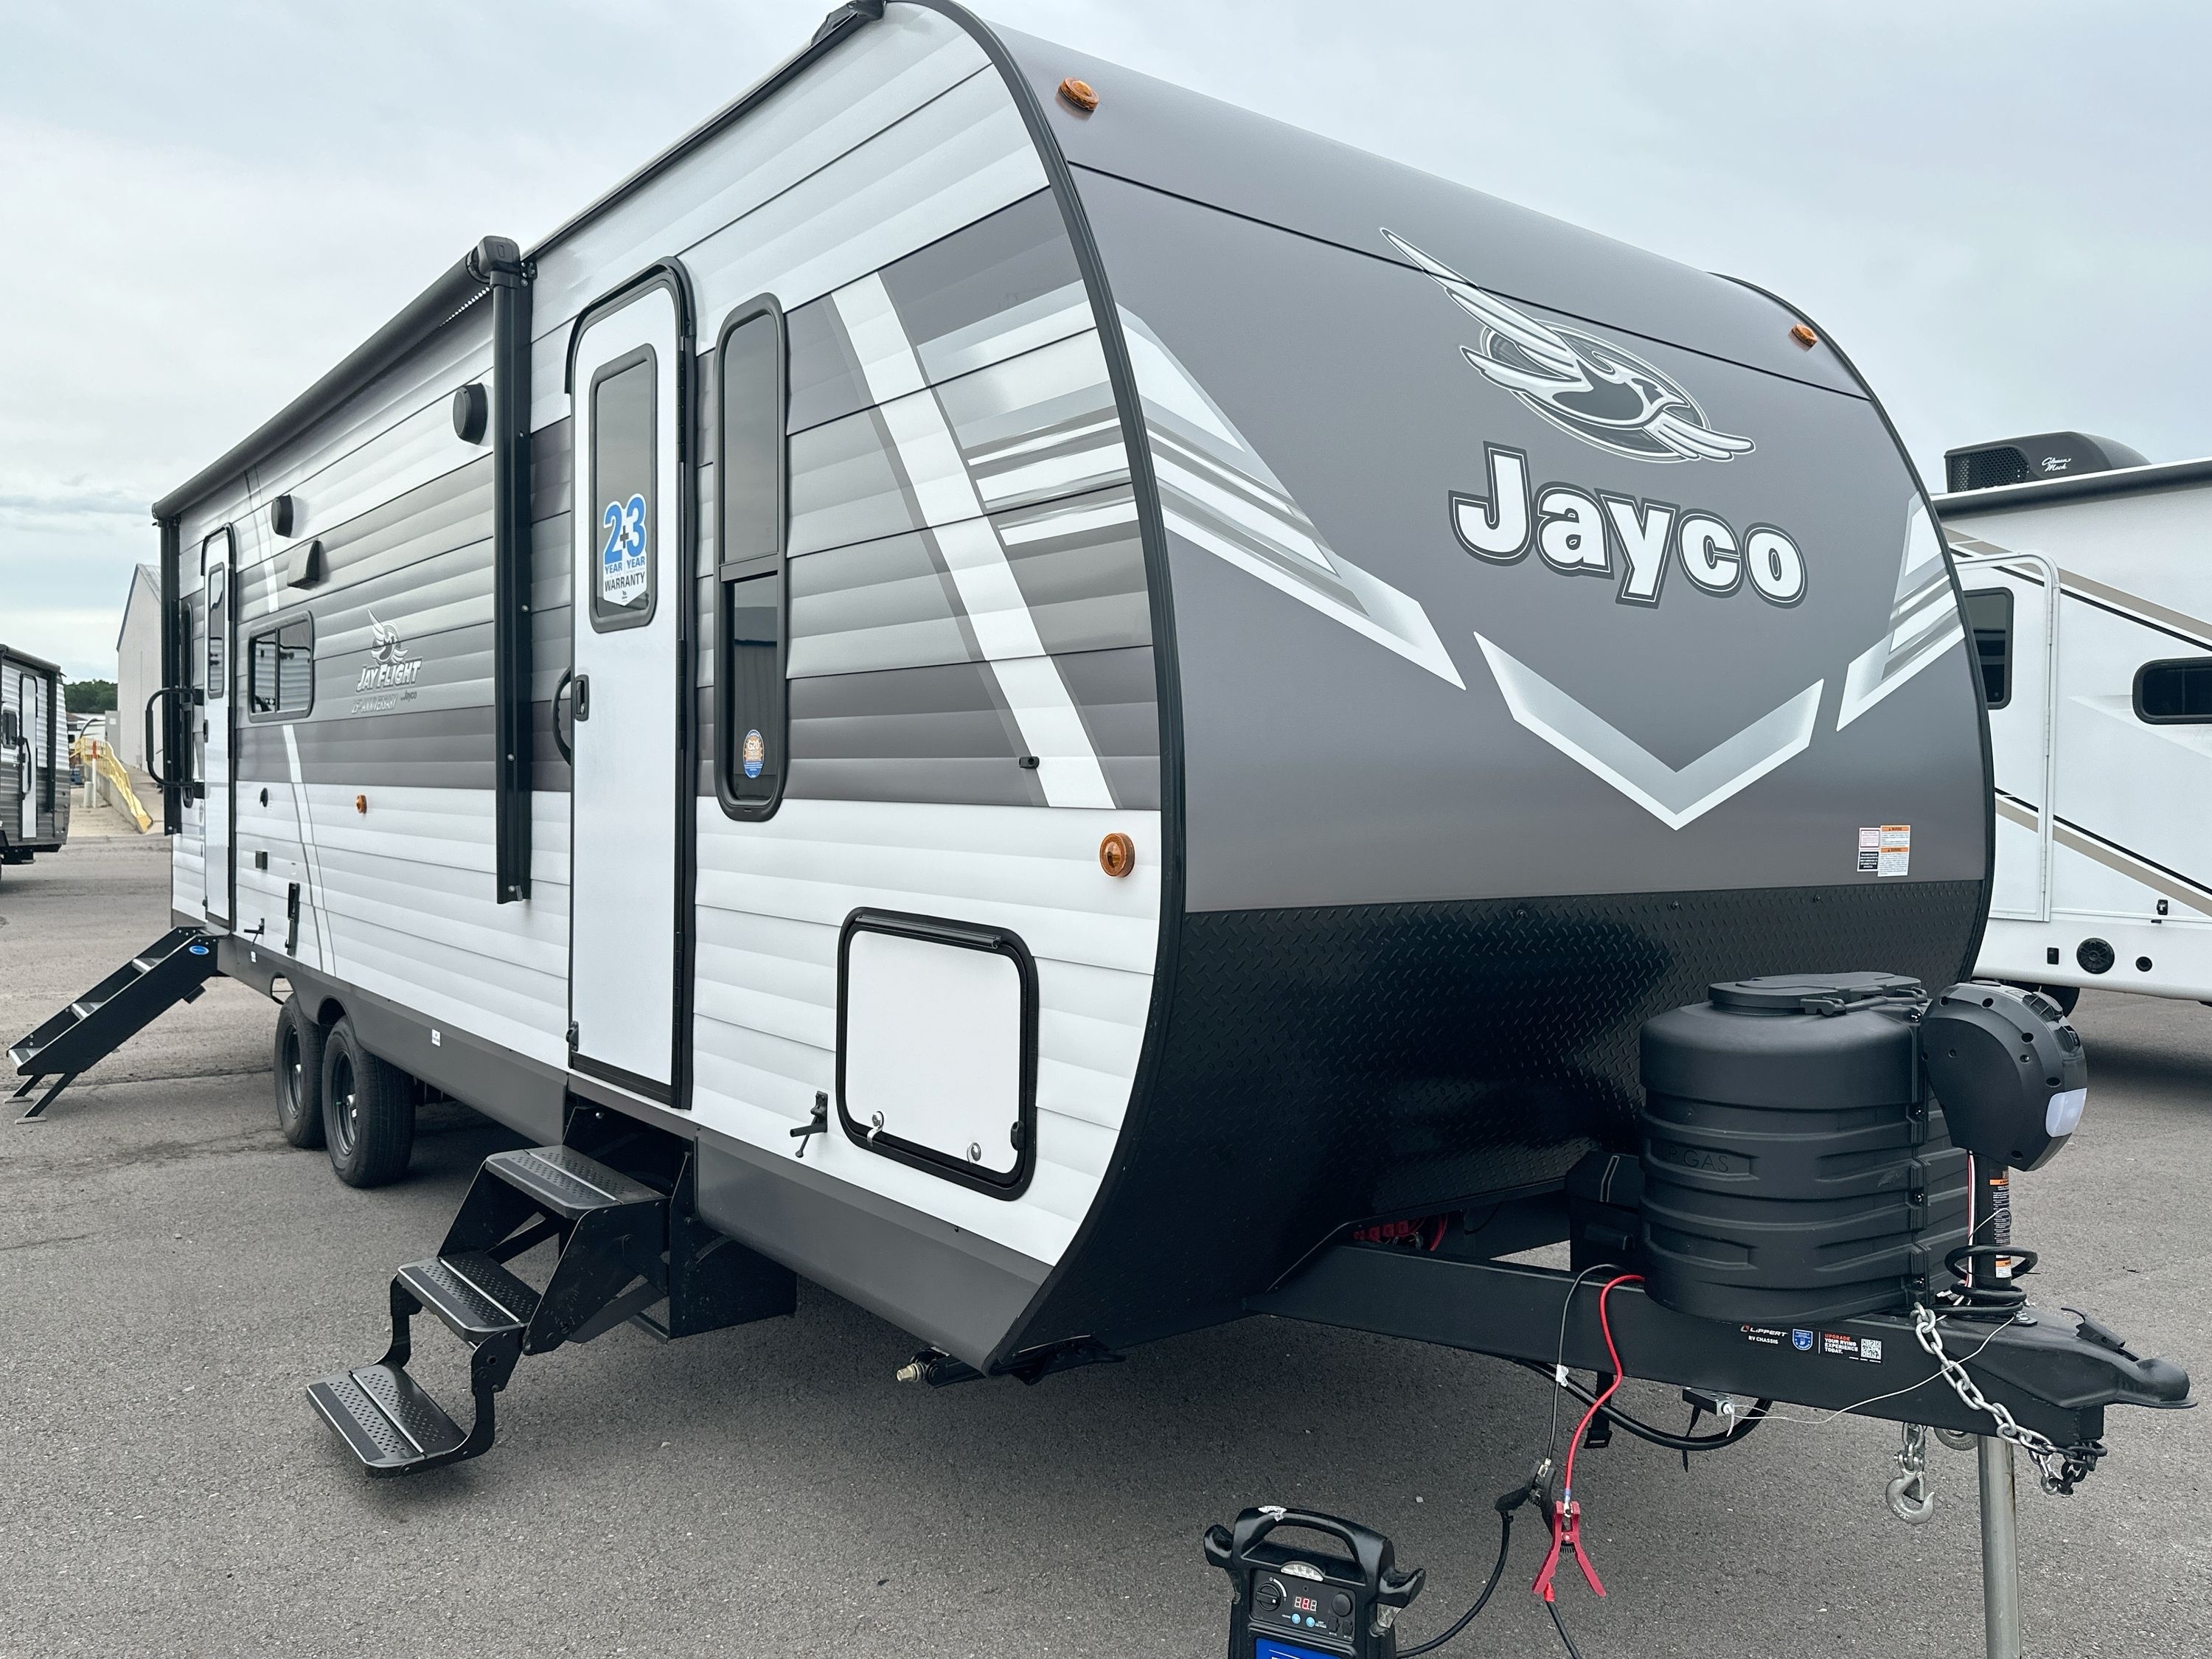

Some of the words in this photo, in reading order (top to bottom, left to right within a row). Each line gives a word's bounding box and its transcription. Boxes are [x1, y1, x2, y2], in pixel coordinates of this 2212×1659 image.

[1448, 441, 1809, 609] Jayco
[605, 563, 623, 574] YEAR
[627, 556, 645, 568] YEAR
[605, 571, 645, 591] WARRANTY
[356, 666, 379, 692] JAY
[376, 658, 422, 689] FLIGHT
[1683, 1149, 1729, 1172] GAS
[1756, 1336, 1778, 1344] CHASSIS
[1824, 1333, 1851, 1341] UPGRADE
[1824, 1342, 1858, 1352] EXPERIENCE
